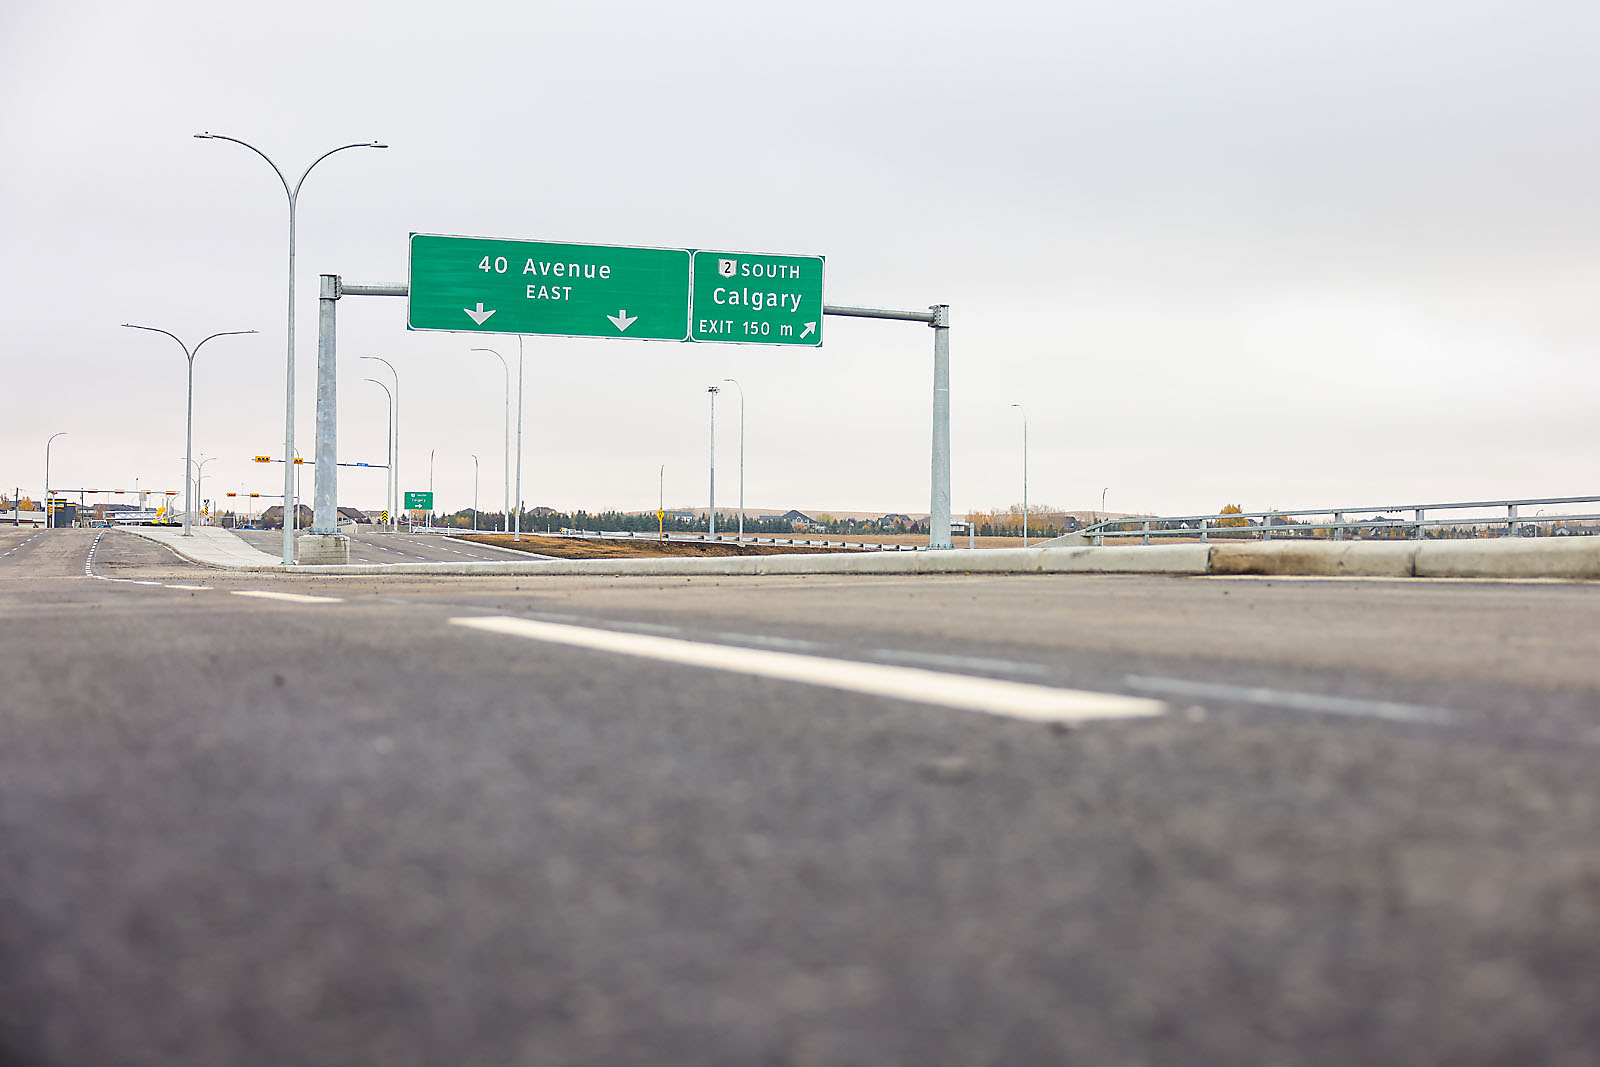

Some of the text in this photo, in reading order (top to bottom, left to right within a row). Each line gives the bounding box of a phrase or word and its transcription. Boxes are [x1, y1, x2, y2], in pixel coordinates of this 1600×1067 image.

[478, 255, 611, 279] 40 Avenue
[724, 261, 801, 279] 2 SOUTH
[526, 284, 572, 301] EAST
[713, 287, 802, 313] Calgary
[699, 319, 793, 337] EXIT 150 m
